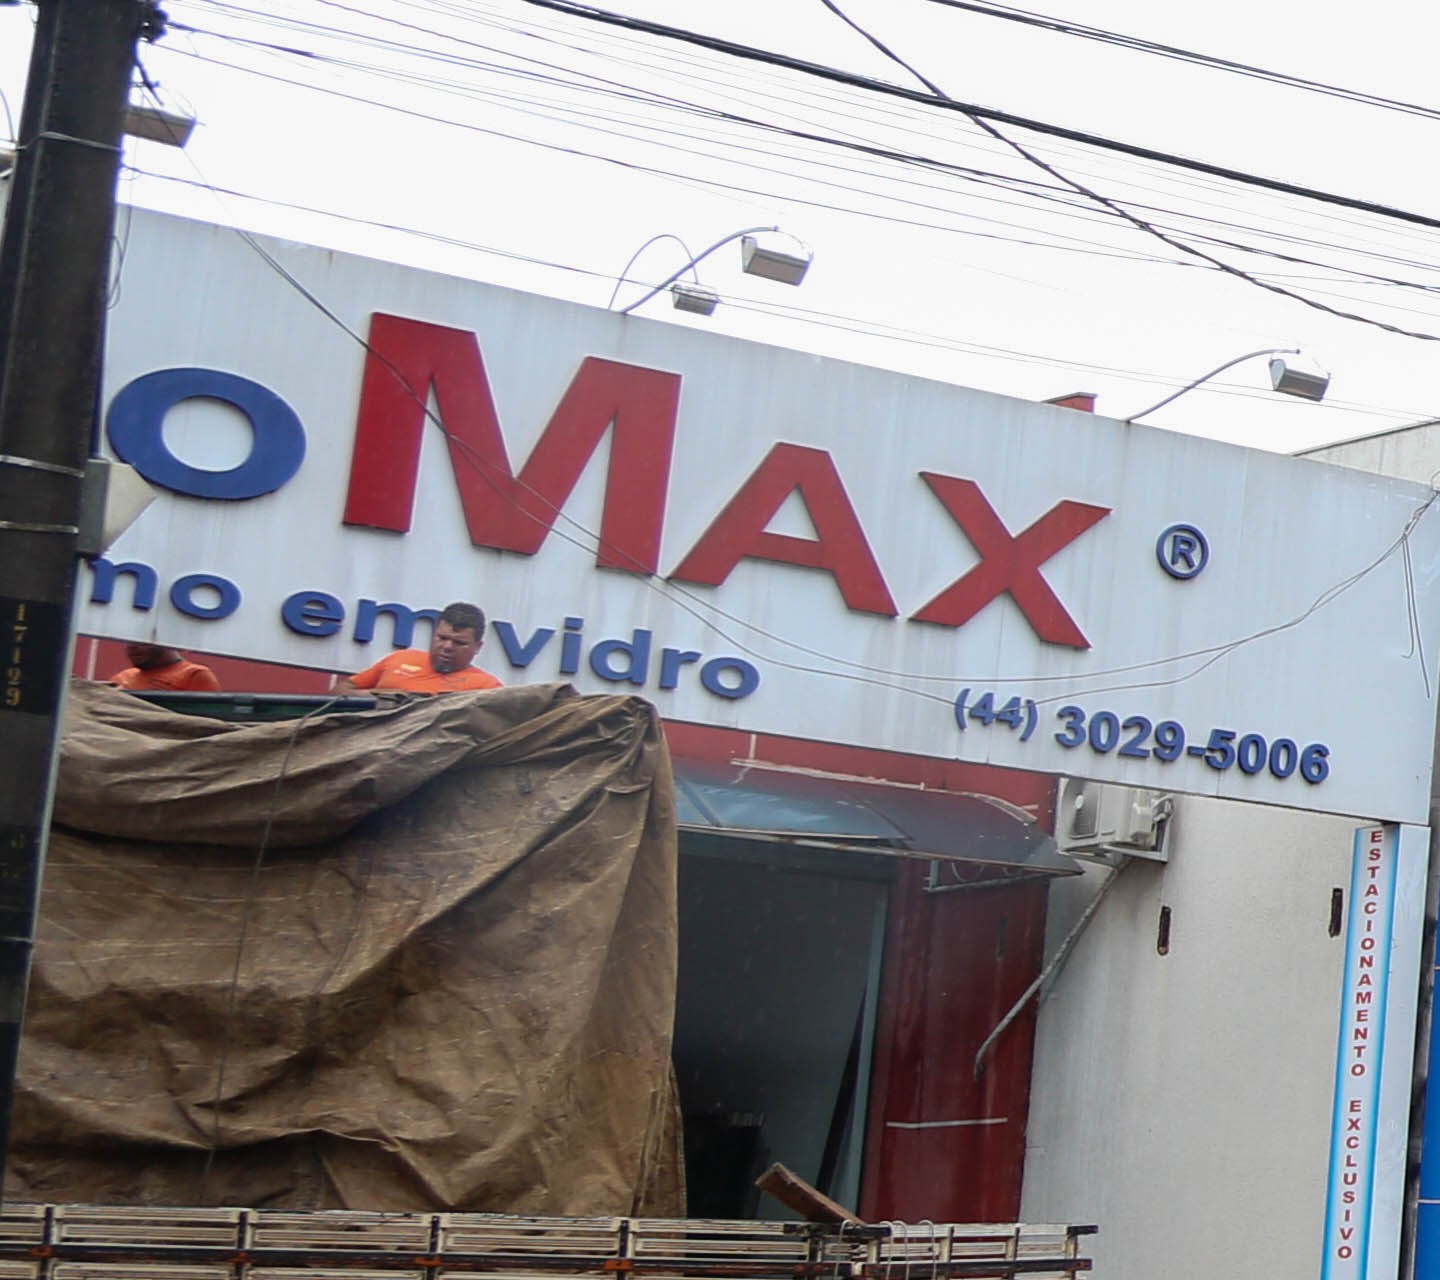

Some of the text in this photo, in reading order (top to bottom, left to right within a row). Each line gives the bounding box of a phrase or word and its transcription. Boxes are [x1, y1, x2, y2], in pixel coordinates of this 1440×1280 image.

[490, 615, 760, 701] vidro
[955, 687, 1332, 785] (44) 3029-5006
[1351, 830, 1383, 1077] ESTACIONAMENTO
[1338, 1100, 1361, 1258] EXCLUSIVO
